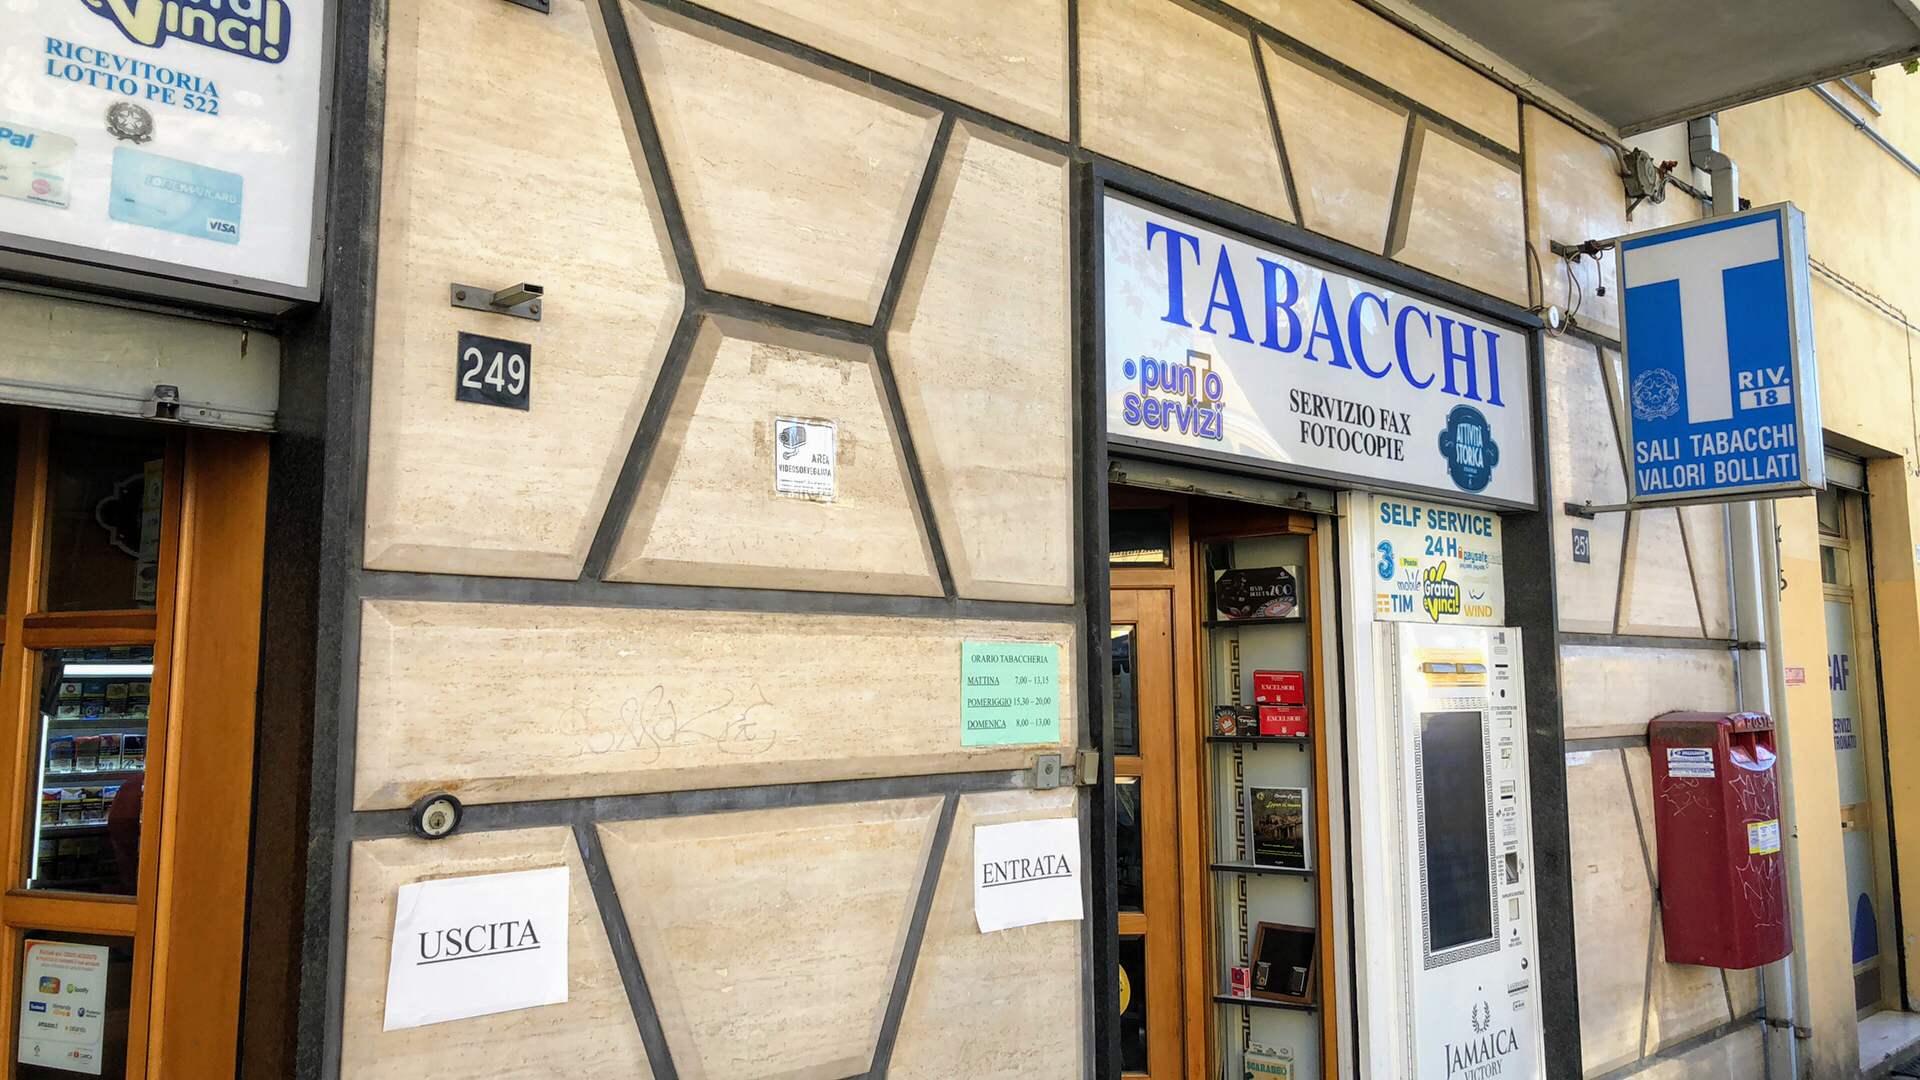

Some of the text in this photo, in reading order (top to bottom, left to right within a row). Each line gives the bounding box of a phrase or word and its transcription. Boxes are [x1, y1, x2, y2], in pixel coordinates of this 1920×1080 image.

[45, 37, 219, 98] RICEVITORIA
[45, 58, 219, 116] LOTTO PE 522
[210, 221, 236, 234] VISA
[1146, 221, 1505, 408] TABACCHI
[1623, 218, 1780, 424] T
[462, 347, 525, 395] 249
[1738, 366, 1790, 390] RIV.
[1753, 389, 1778, 406] 18
[1123, 392, 1223, 441] servizi
[1289, 388, 1412, 436] SERVIZIO FAX
[1299, 420, 1405, 462] FOTOCOPIE
[1636, 423, 1795, 464] SALI TABACCHI
[1455, 443, 1484, 468] STORICA
[1638, 452, 1798, 491] VALORI BOLLATI
[1380, 502, 1493, 537] SELF SERVICE
[1424, 535, 1457, 558] 24 H
[1573, 535, 1589, 556] 251
[1270, 584, 1293, 596] 200
[1425, 580, 1455, 597] Gratta
[1391, 594, 1413, 613] TIM
[1463, 605, 1493, 618] WIND
[971, 654, 1048, 663] ORARIO TABACCHERIA
[967, 676, 1000, 686] MATTINA
[967, 698, 1012, 708] POMERIGGIO
[967, 719, 1007, 730] DOMENICA
[982, 854, 1072, 886] ENTRATA
[417, 918, 540, 962] USCITA
[74, 986, 89, 995] Spotify
[1444, 1026, 1519, 1080] JAMAICA
